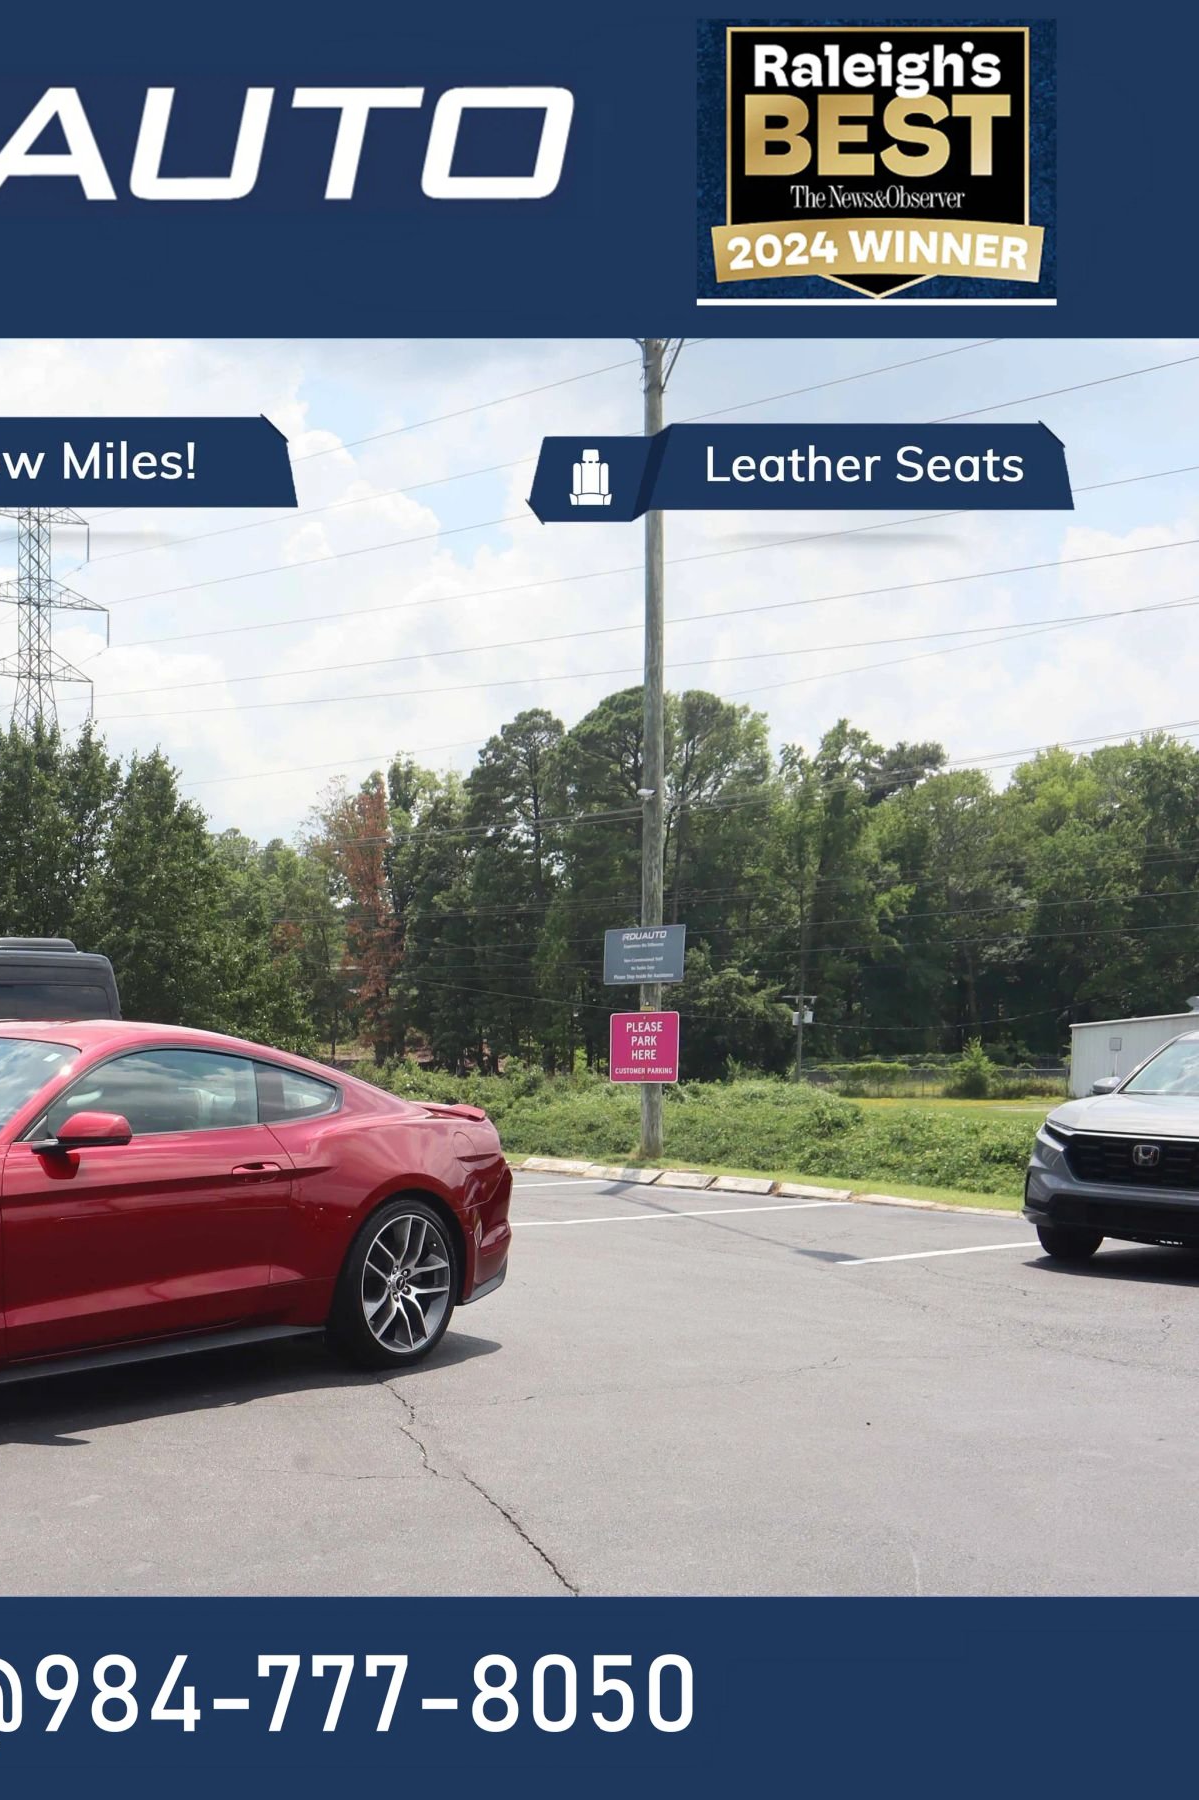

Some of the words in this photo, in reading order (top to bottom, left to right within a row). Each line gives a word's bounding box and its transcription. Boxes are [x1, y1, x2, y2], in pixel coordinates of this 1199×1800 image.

[626, 1021, 664, 1033] PLEASE
[631, 1035, 657, 1046] PARK
[631, 1049, 657, 1060] HERE
[614, 1067, 646, 1075] CUSTOMER
[647, 1067, 673, 1075] PARKING
